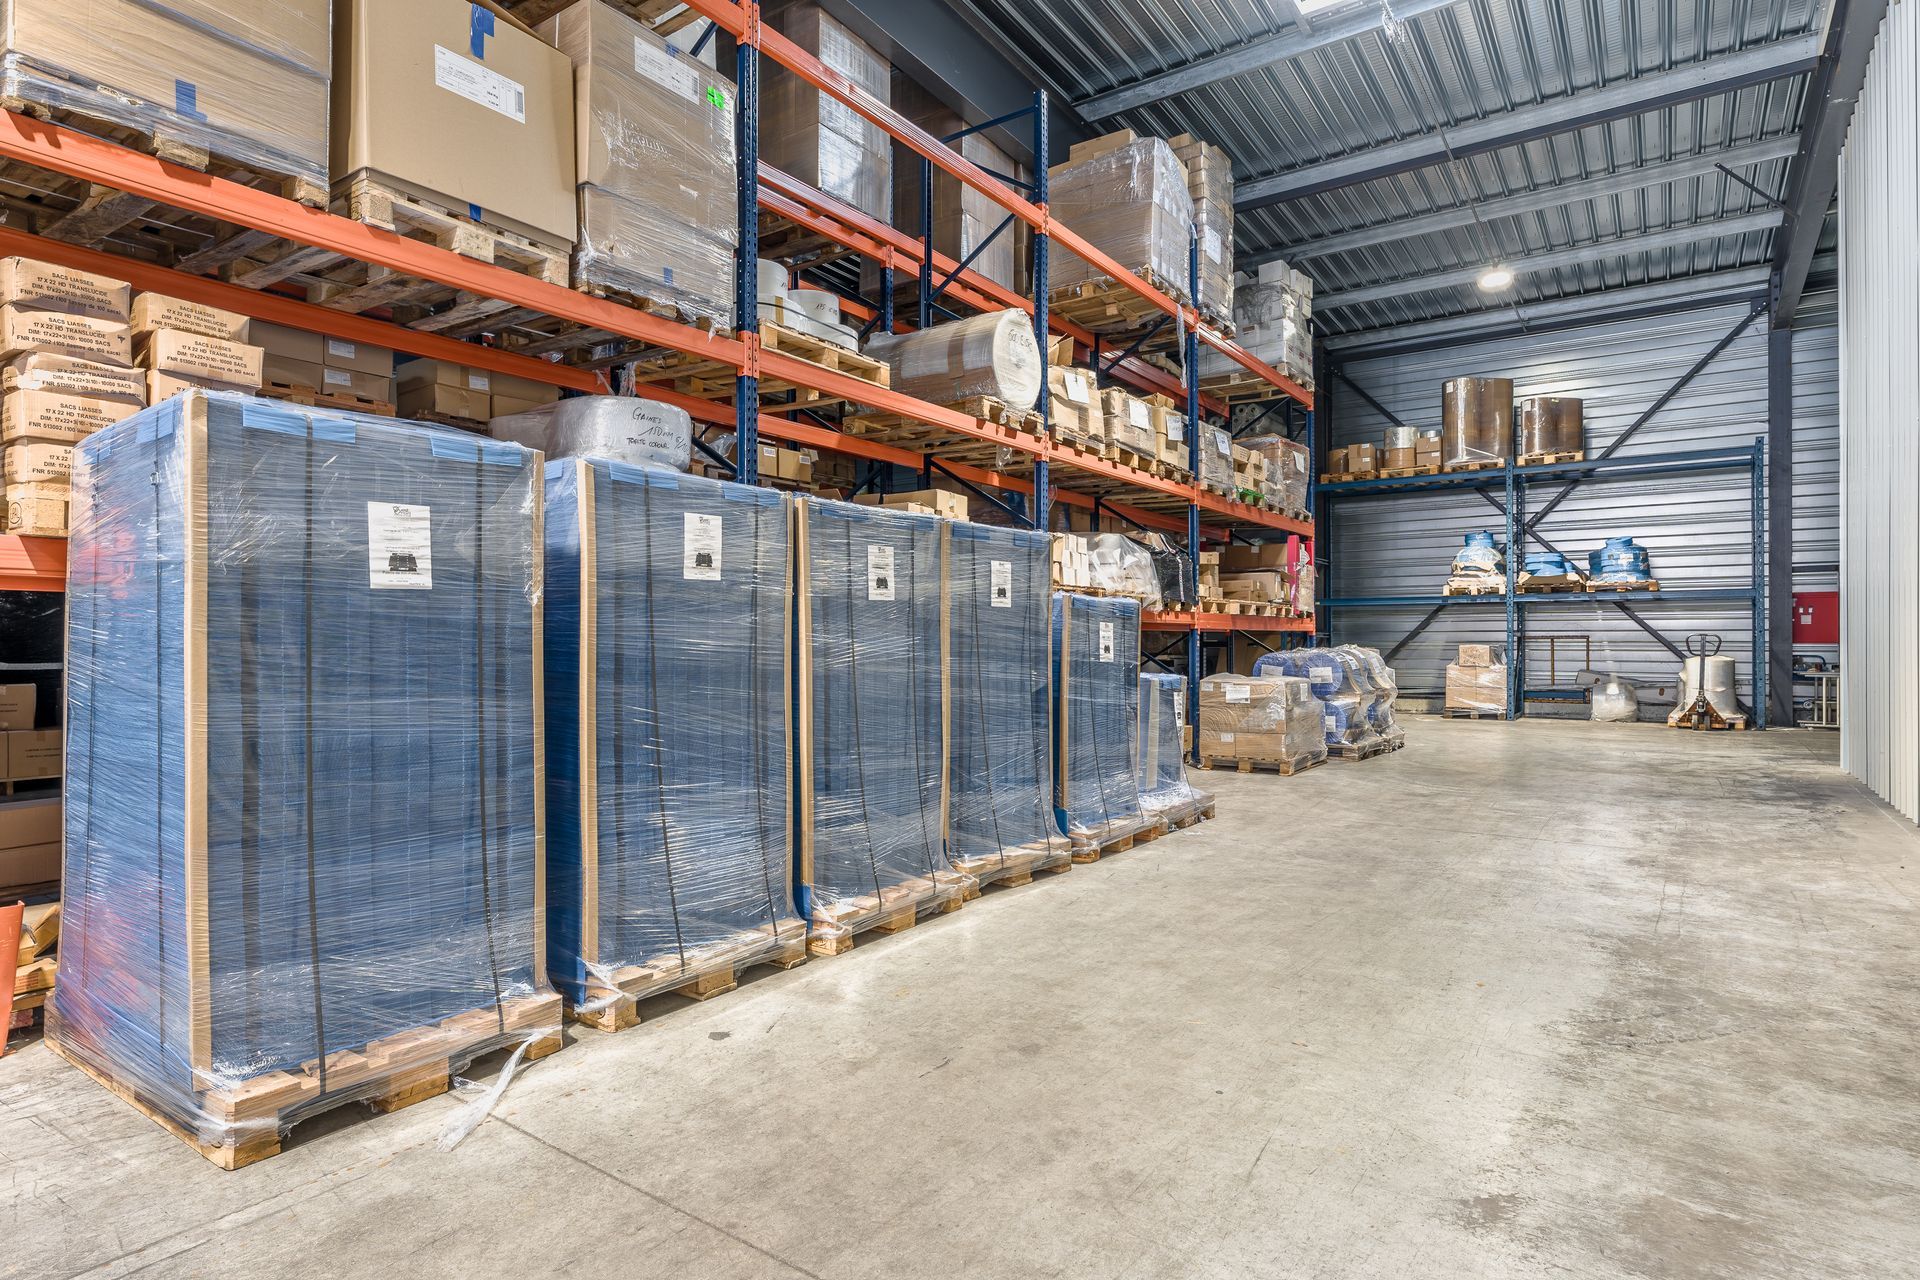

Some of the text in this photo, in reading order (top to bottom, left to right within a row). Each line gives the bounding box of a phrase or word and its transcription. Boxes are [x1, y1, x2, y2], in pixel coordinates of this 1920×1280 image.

[52, 273, 94, 286] SACS LIASSES
[69, 283, 108, 297] TRANSLUCIDE
[35, 291, 54, 300] 513002
[96, 297, 112, 305] SACS
[195, 309, 215, 319] LIASSES
[48, 317, 92, 329] SACS LIASSES
[194, 315, 228, 328] TRANSLUCIDE
[66, 328, 106, 339] TRANSLUCIDE
[32, 336, 51, 345] 513002
[210, 344, 232, 352] LIASSES
[209, 350, 243, 361] TRANSLUCIDE
[88, 372, 127, 380] TRANSLUCIDE
[78, 406, 102, 414] LIASSES
[77, 413, 116, 423] TRANSLUCIDE
